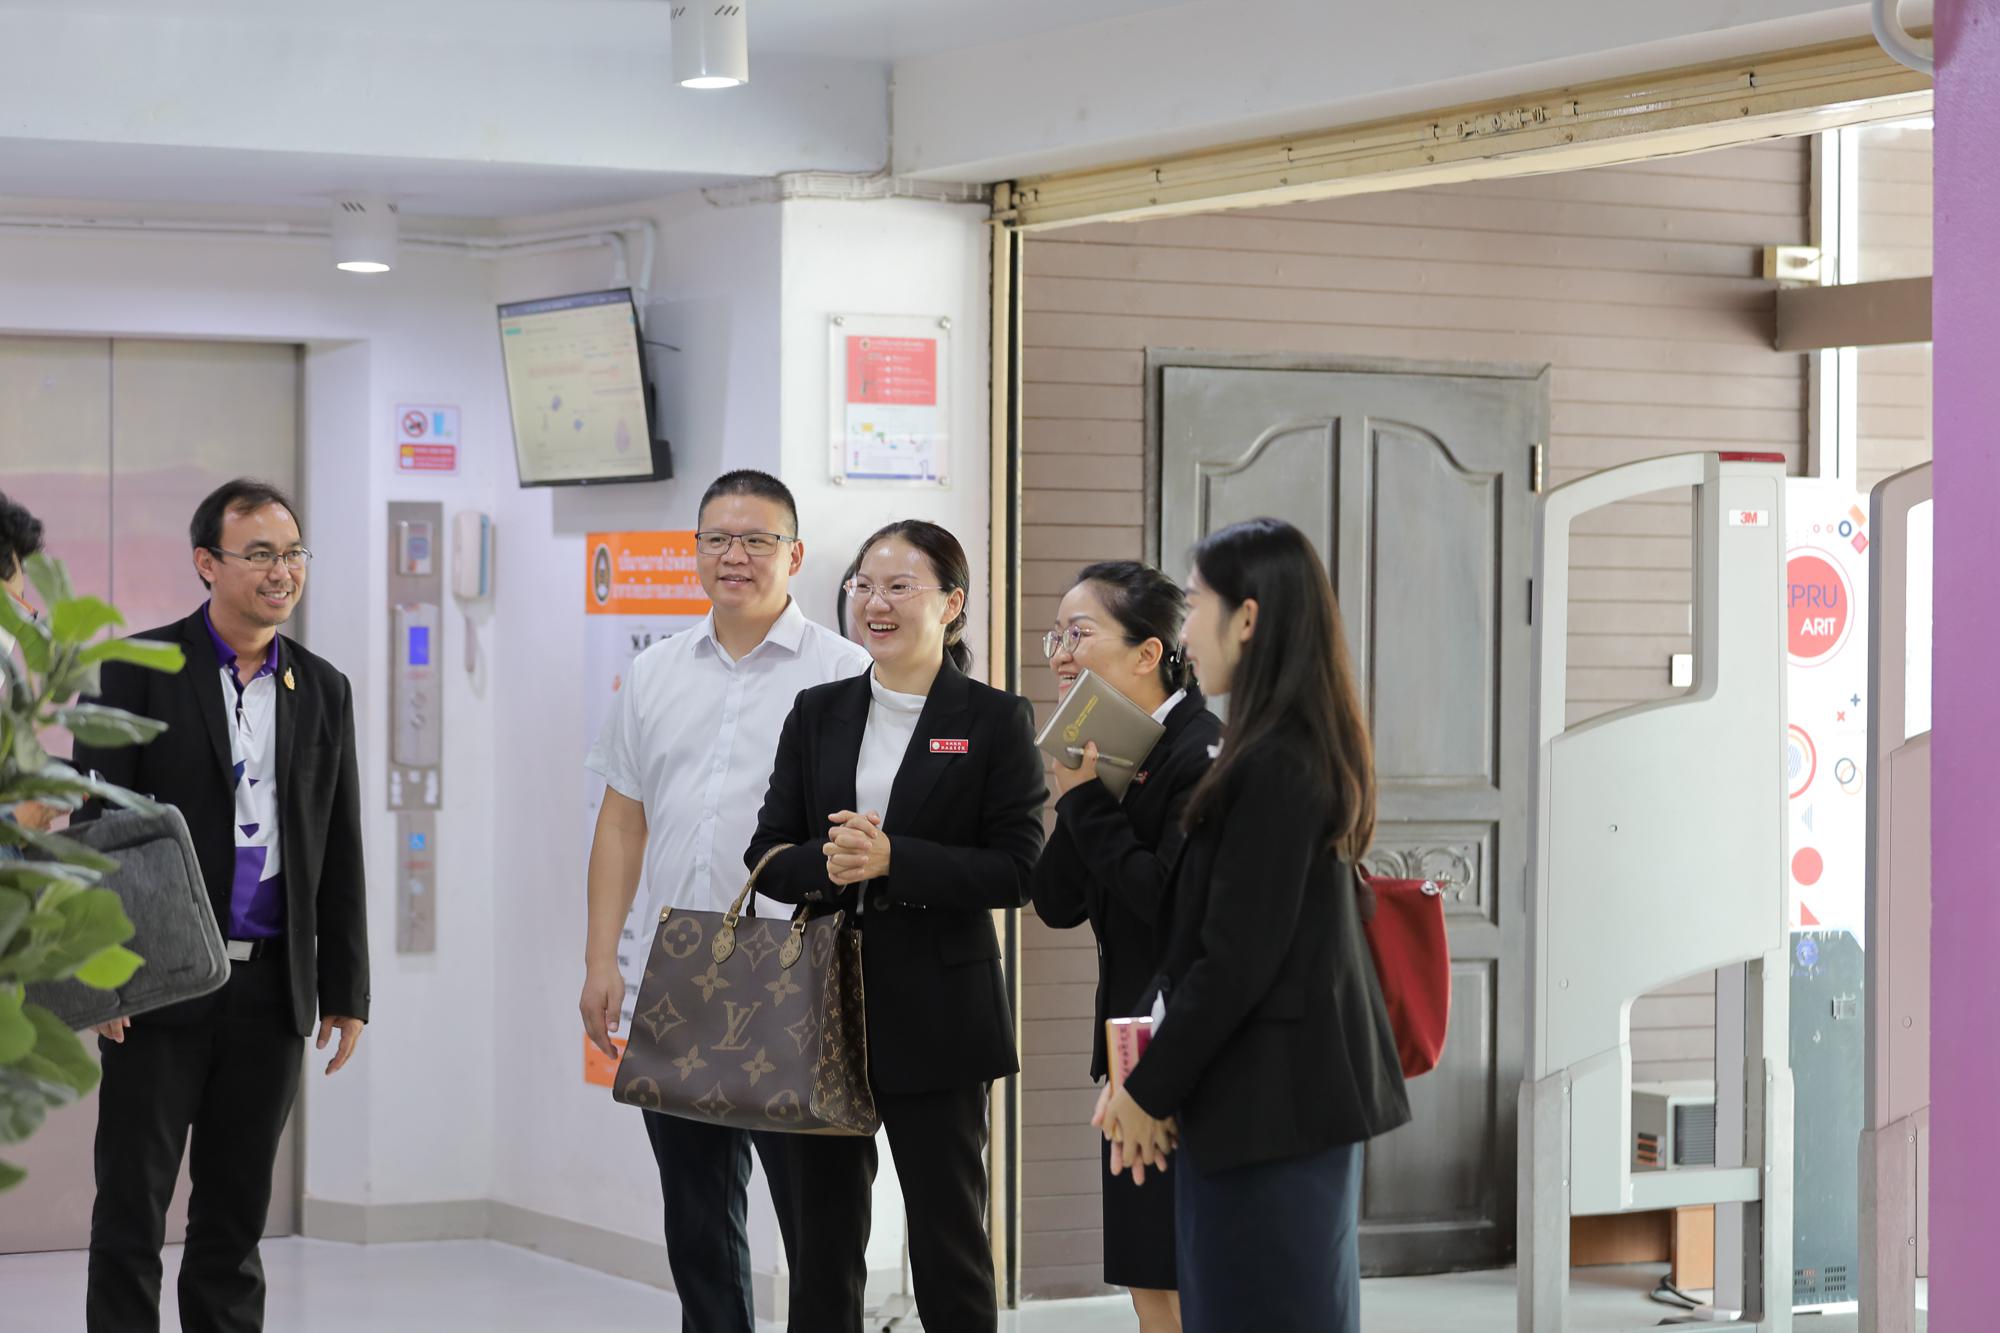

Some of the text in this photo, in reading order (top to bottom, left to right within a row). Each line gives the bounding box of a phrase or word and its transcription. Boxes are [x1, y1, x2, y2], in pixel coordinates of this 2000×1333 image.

[1740, 511, 1758, 524] 3M
[1787, 584, 1837, 608] PRU
[1800, 617, 1837, 636] ARIT
